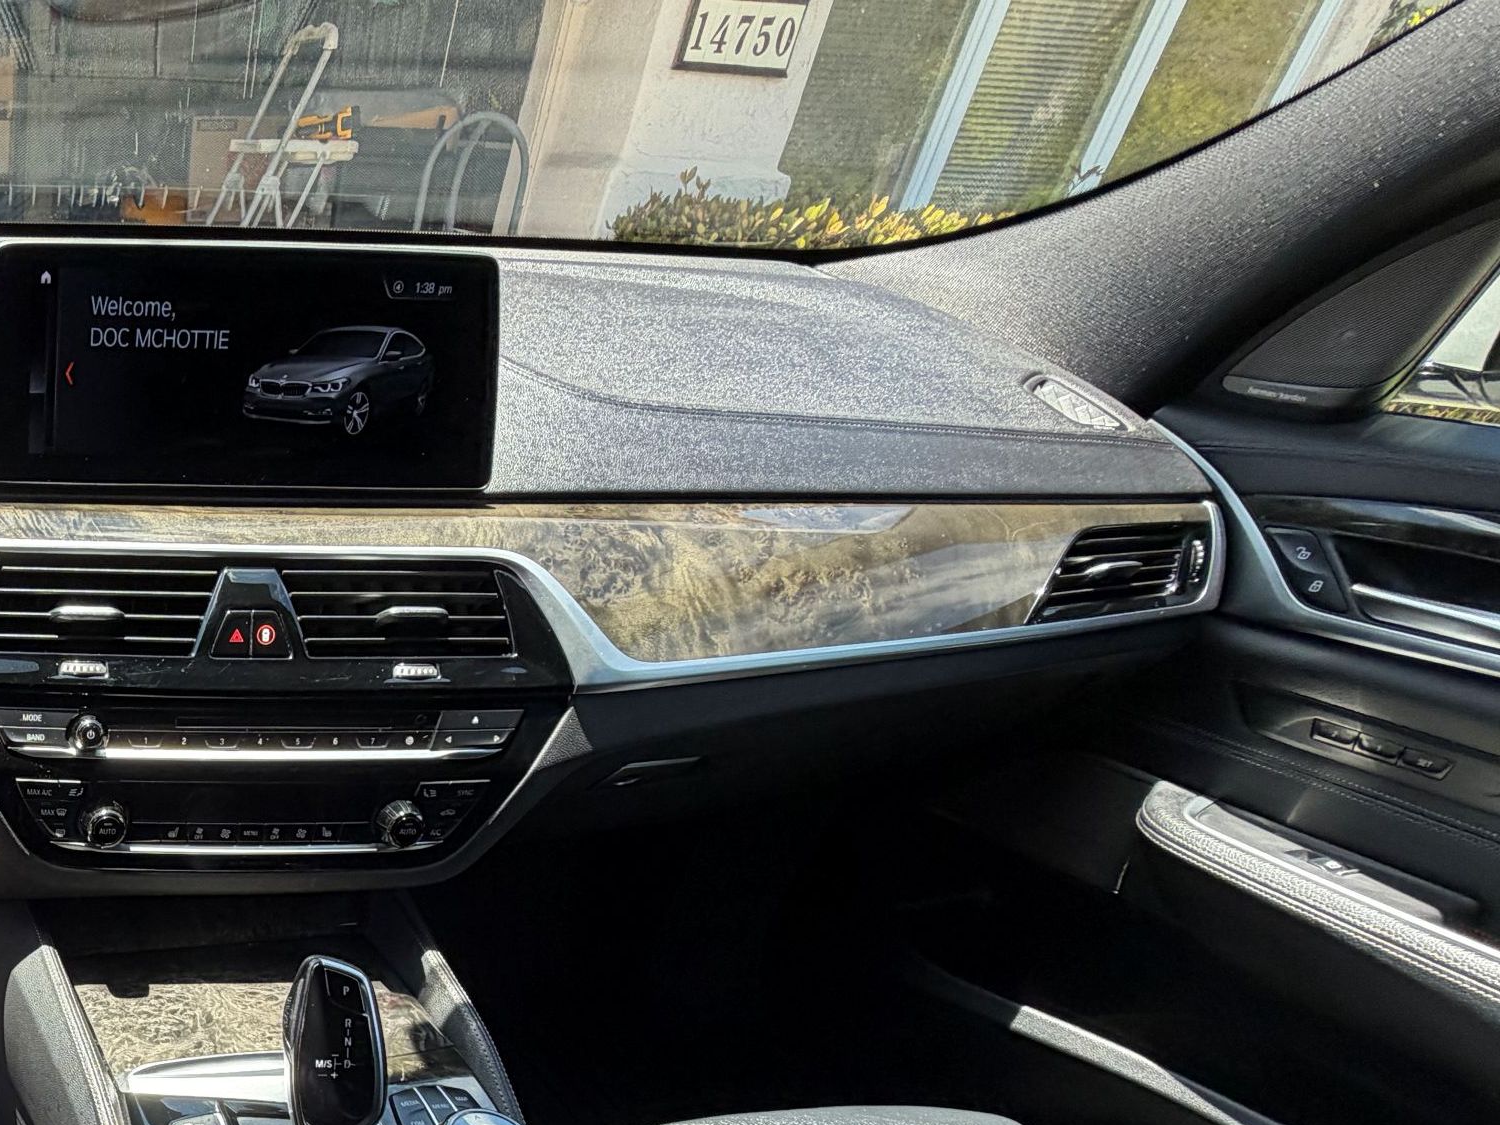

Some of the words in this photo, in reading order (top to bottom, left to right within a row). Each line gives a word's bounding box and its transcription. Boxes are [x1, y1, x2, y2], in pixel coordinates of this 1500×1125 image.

[690, 11, 796, 57] 14750
[415, 282, 436, 294] 1:38
[437, 286, 453, 297] pm
[91, 295, 176, 321] Welcome,
[90, 327, 130, 348] DOC
[135, 328, 230, 350] MCHOTTIE
[22, 713, 43, 722] MODE
[26, 733, 46, 741] BAND
[26, 788, 40, 796] MAX
[40, 808, 55, 816] MAX
[343, 986, 350, 996] P
[344, 1018, 352, 1028] R
[344, 1037, 352, 1046] N
[315, 1059, 333, 1068] M/S
